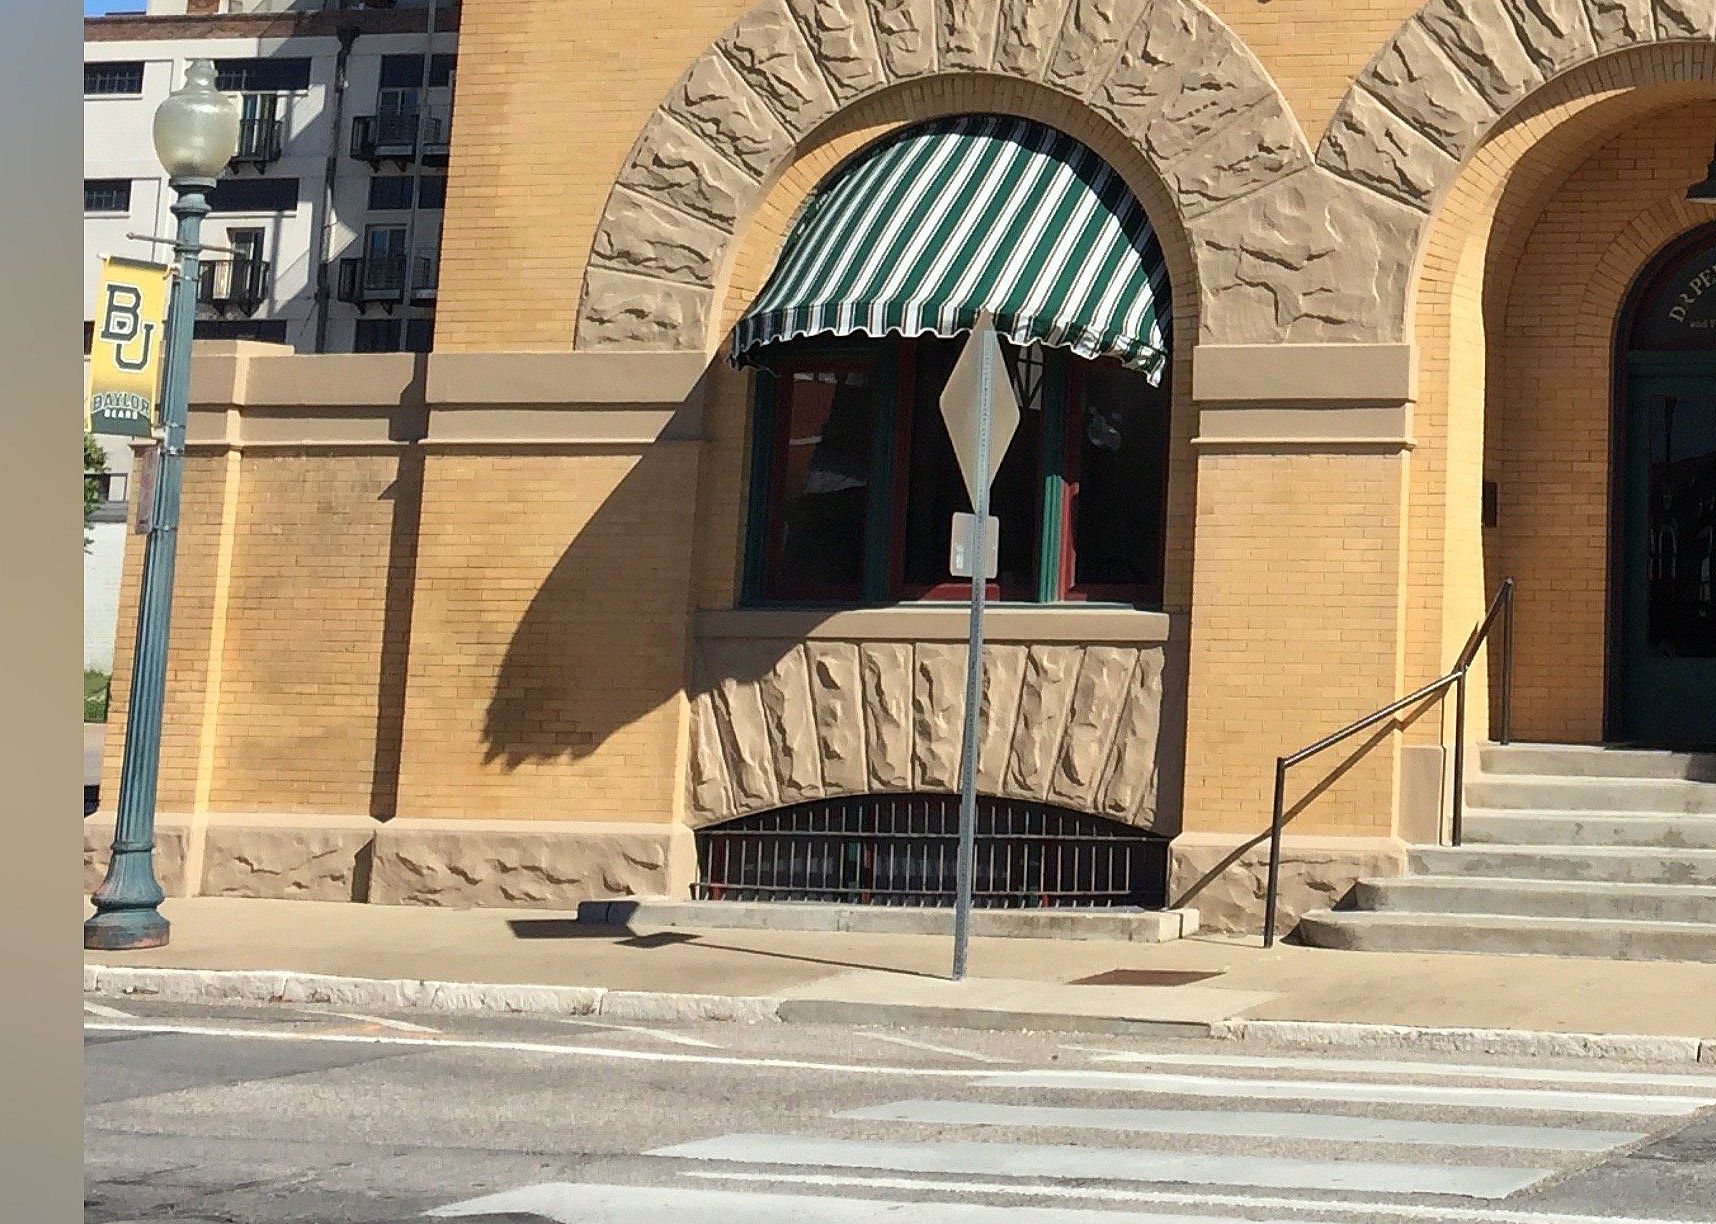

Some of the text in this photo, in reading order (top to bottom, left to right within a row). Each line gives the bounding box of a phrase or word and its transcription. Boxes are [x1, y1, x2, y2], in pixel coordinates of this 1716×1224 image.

[100, 283, 155, 371] BU
[93, 392, 149, 419] BAYLOR
[104, 407, 138, 420] BEARS
